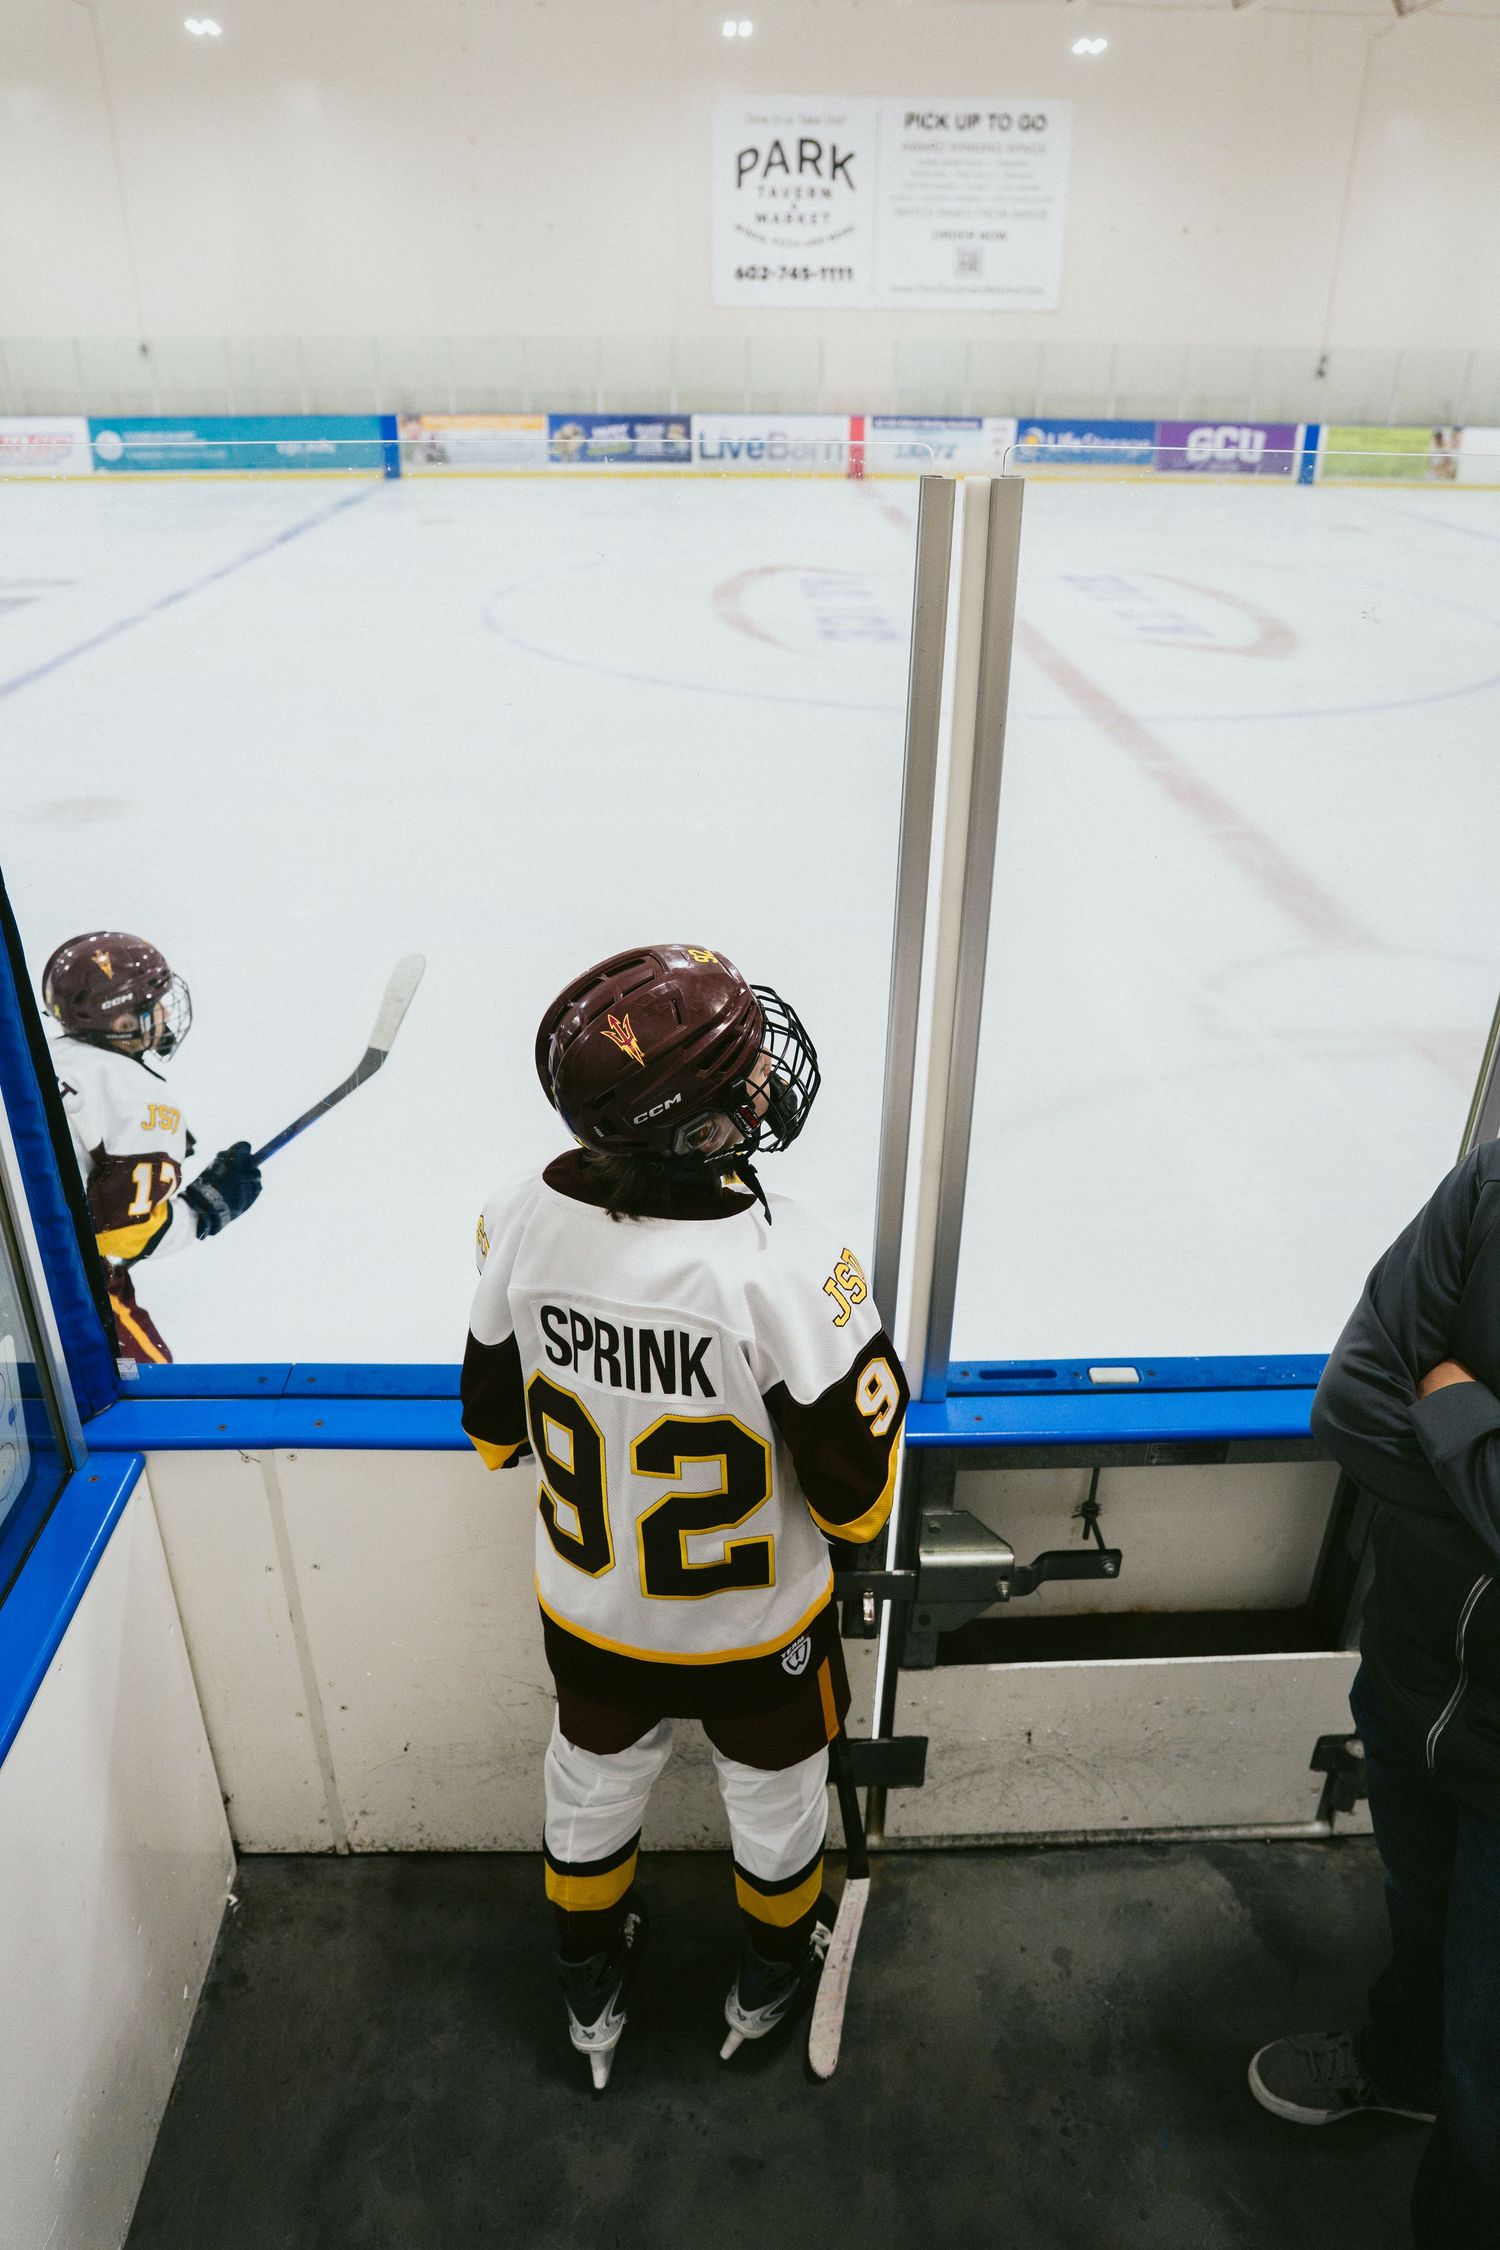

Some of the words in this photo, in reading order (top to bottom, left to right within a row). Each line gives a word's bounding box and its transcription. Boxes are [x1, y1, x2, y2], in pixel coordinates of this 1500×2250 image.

[904, 112, 950, 131] PICK
[954, 112, 983, 131] UP
[987, 112, 1013, 131] TO
[1017, 112, 1048, 131] GO
[736, 138, 856, 191] PARK
[757, 185, 833, 199] TAVERN
[755, 212, 831, 224] MARKET
[1187, 426, 1268, 463] GCU
[633, 1093, 682, 1125] CCM
[540, 1304, 718, 1400] SPRINK
[525, 1369, 777, 1599] 92
